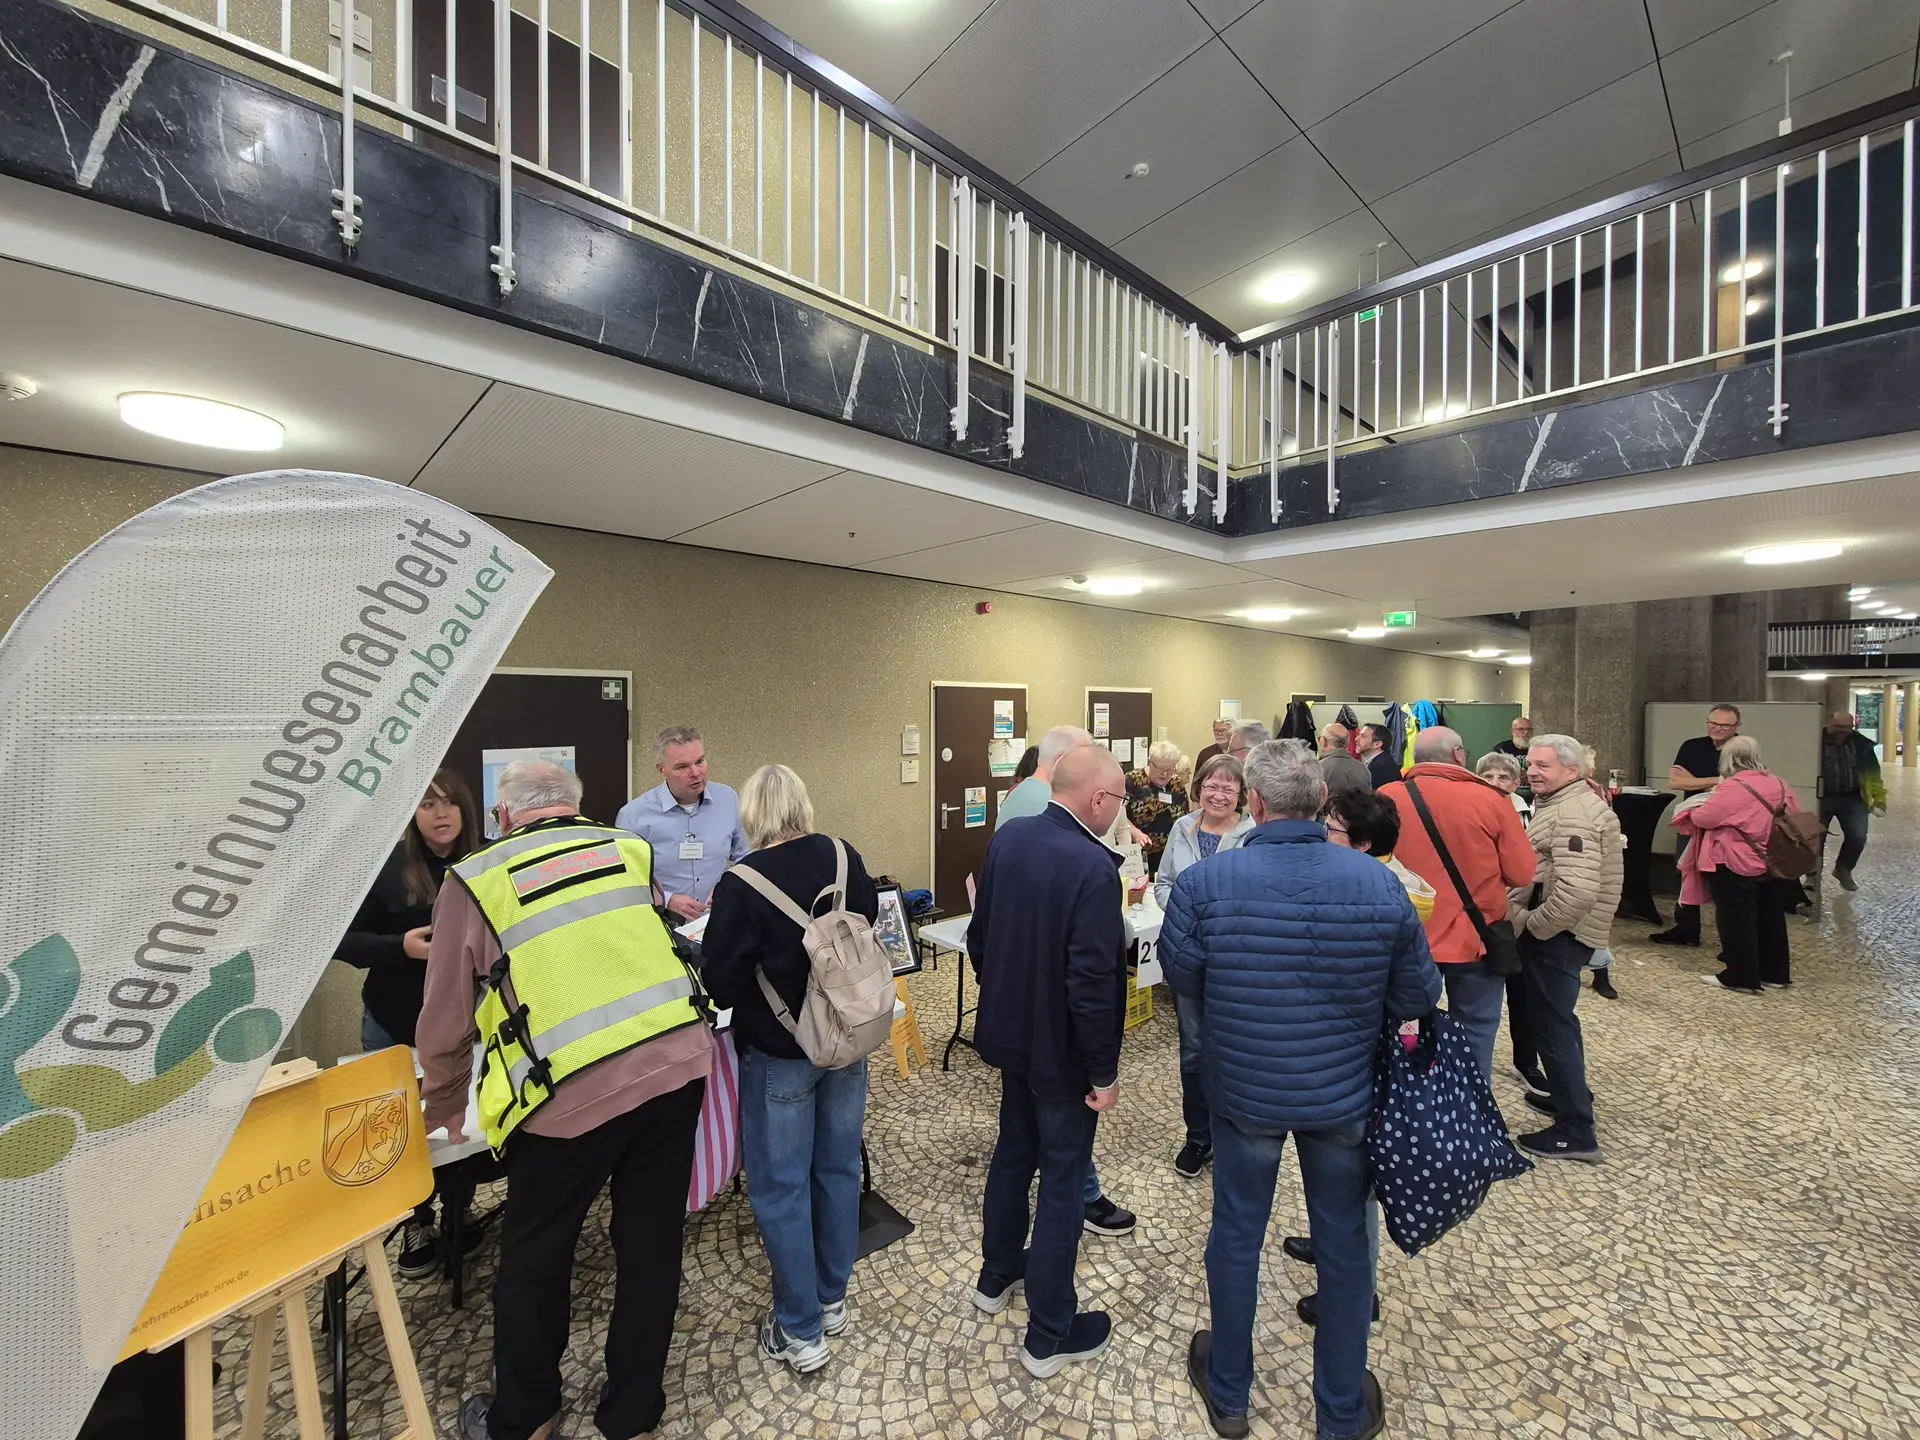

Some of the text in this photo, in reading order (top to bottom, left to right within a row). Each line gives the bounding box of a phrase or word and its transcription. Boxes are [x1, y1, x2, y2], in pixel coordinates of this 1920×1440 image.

[61, 518, 471, 1051] Gemeinwesenarbeit
[337, 545, 515, 797] Brambauer
[184, 1158, 312, 1229] nsache
